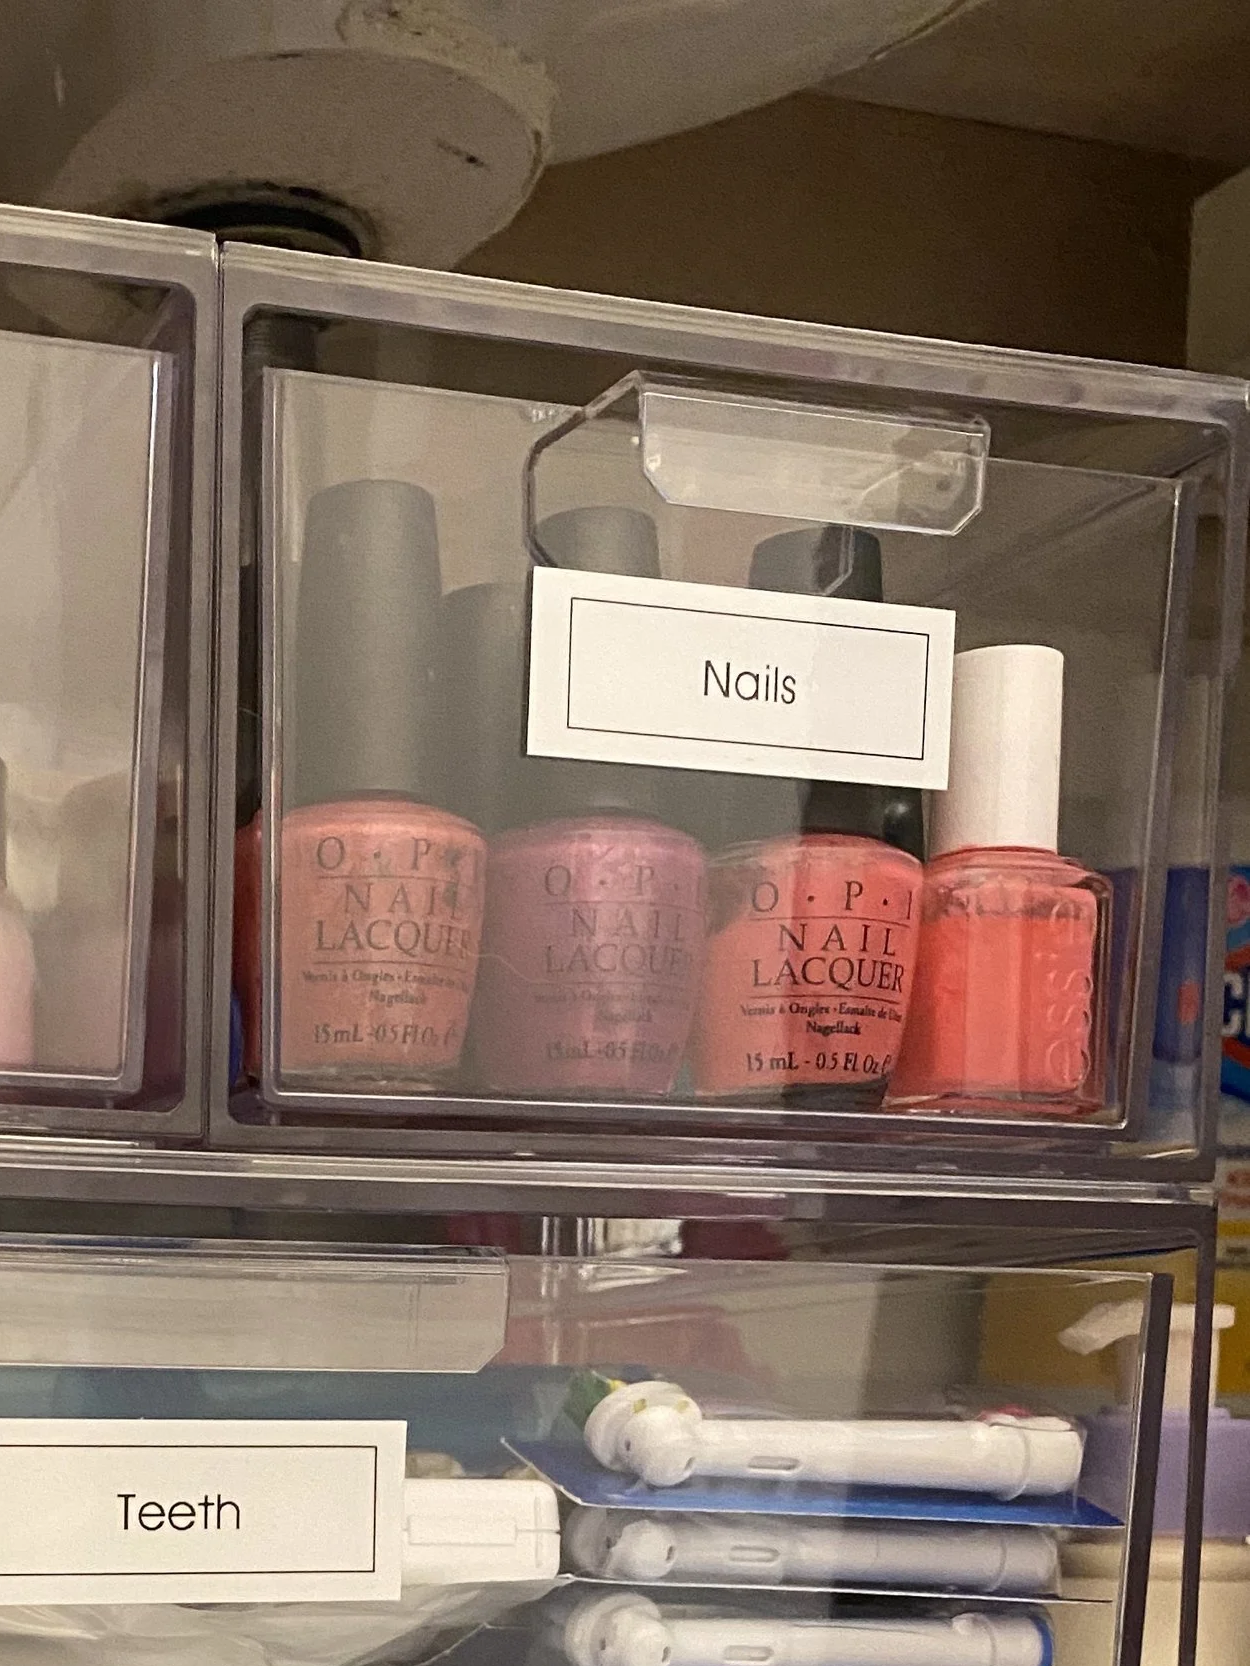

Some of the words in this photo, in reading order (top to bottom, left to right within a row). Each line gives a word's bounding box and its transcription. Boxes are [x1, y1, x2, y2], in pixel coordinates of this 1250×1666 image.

[703, 659, 797, 705] Nails
[778, 923, 896, 957] NAIL
[752, 956, 905, 993] LACQUER
[770, 1051, 799, 1072] mL
[116, 1493, 242, 1532] Teeth
